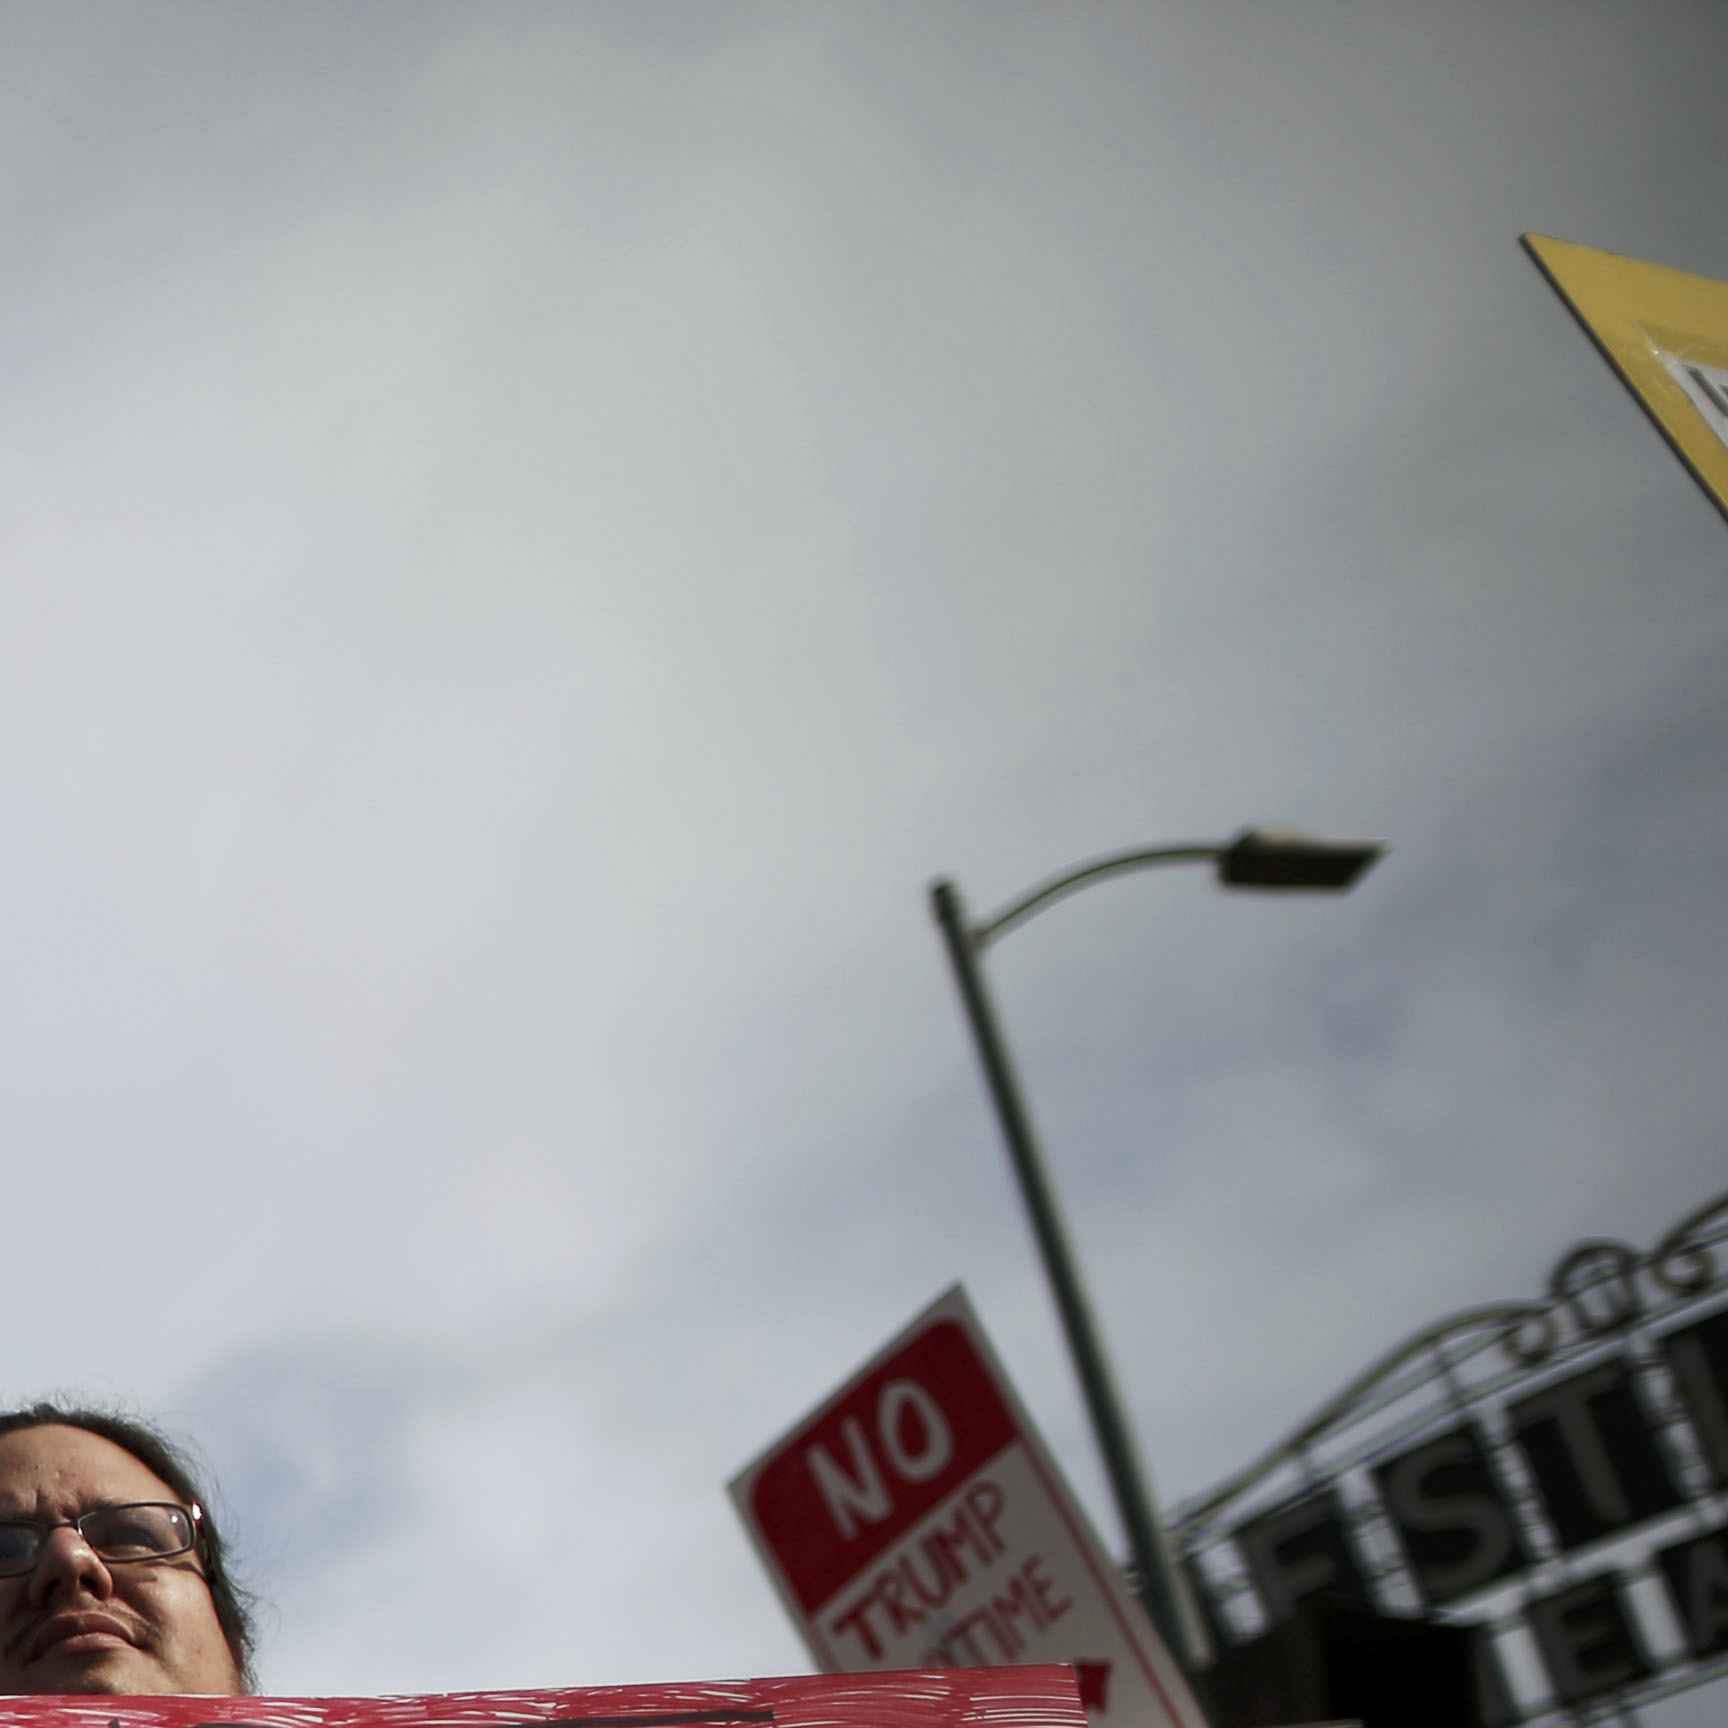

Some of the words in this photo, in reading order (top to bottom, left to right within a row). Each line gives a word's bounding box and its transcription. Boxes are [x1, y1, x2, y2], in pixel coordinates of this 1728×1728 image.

[806, 1376, 956, 1540] NO
[832, 1480, 1006, 1662] TRUMP
[922, 1554, 1075, 1669] TIME
